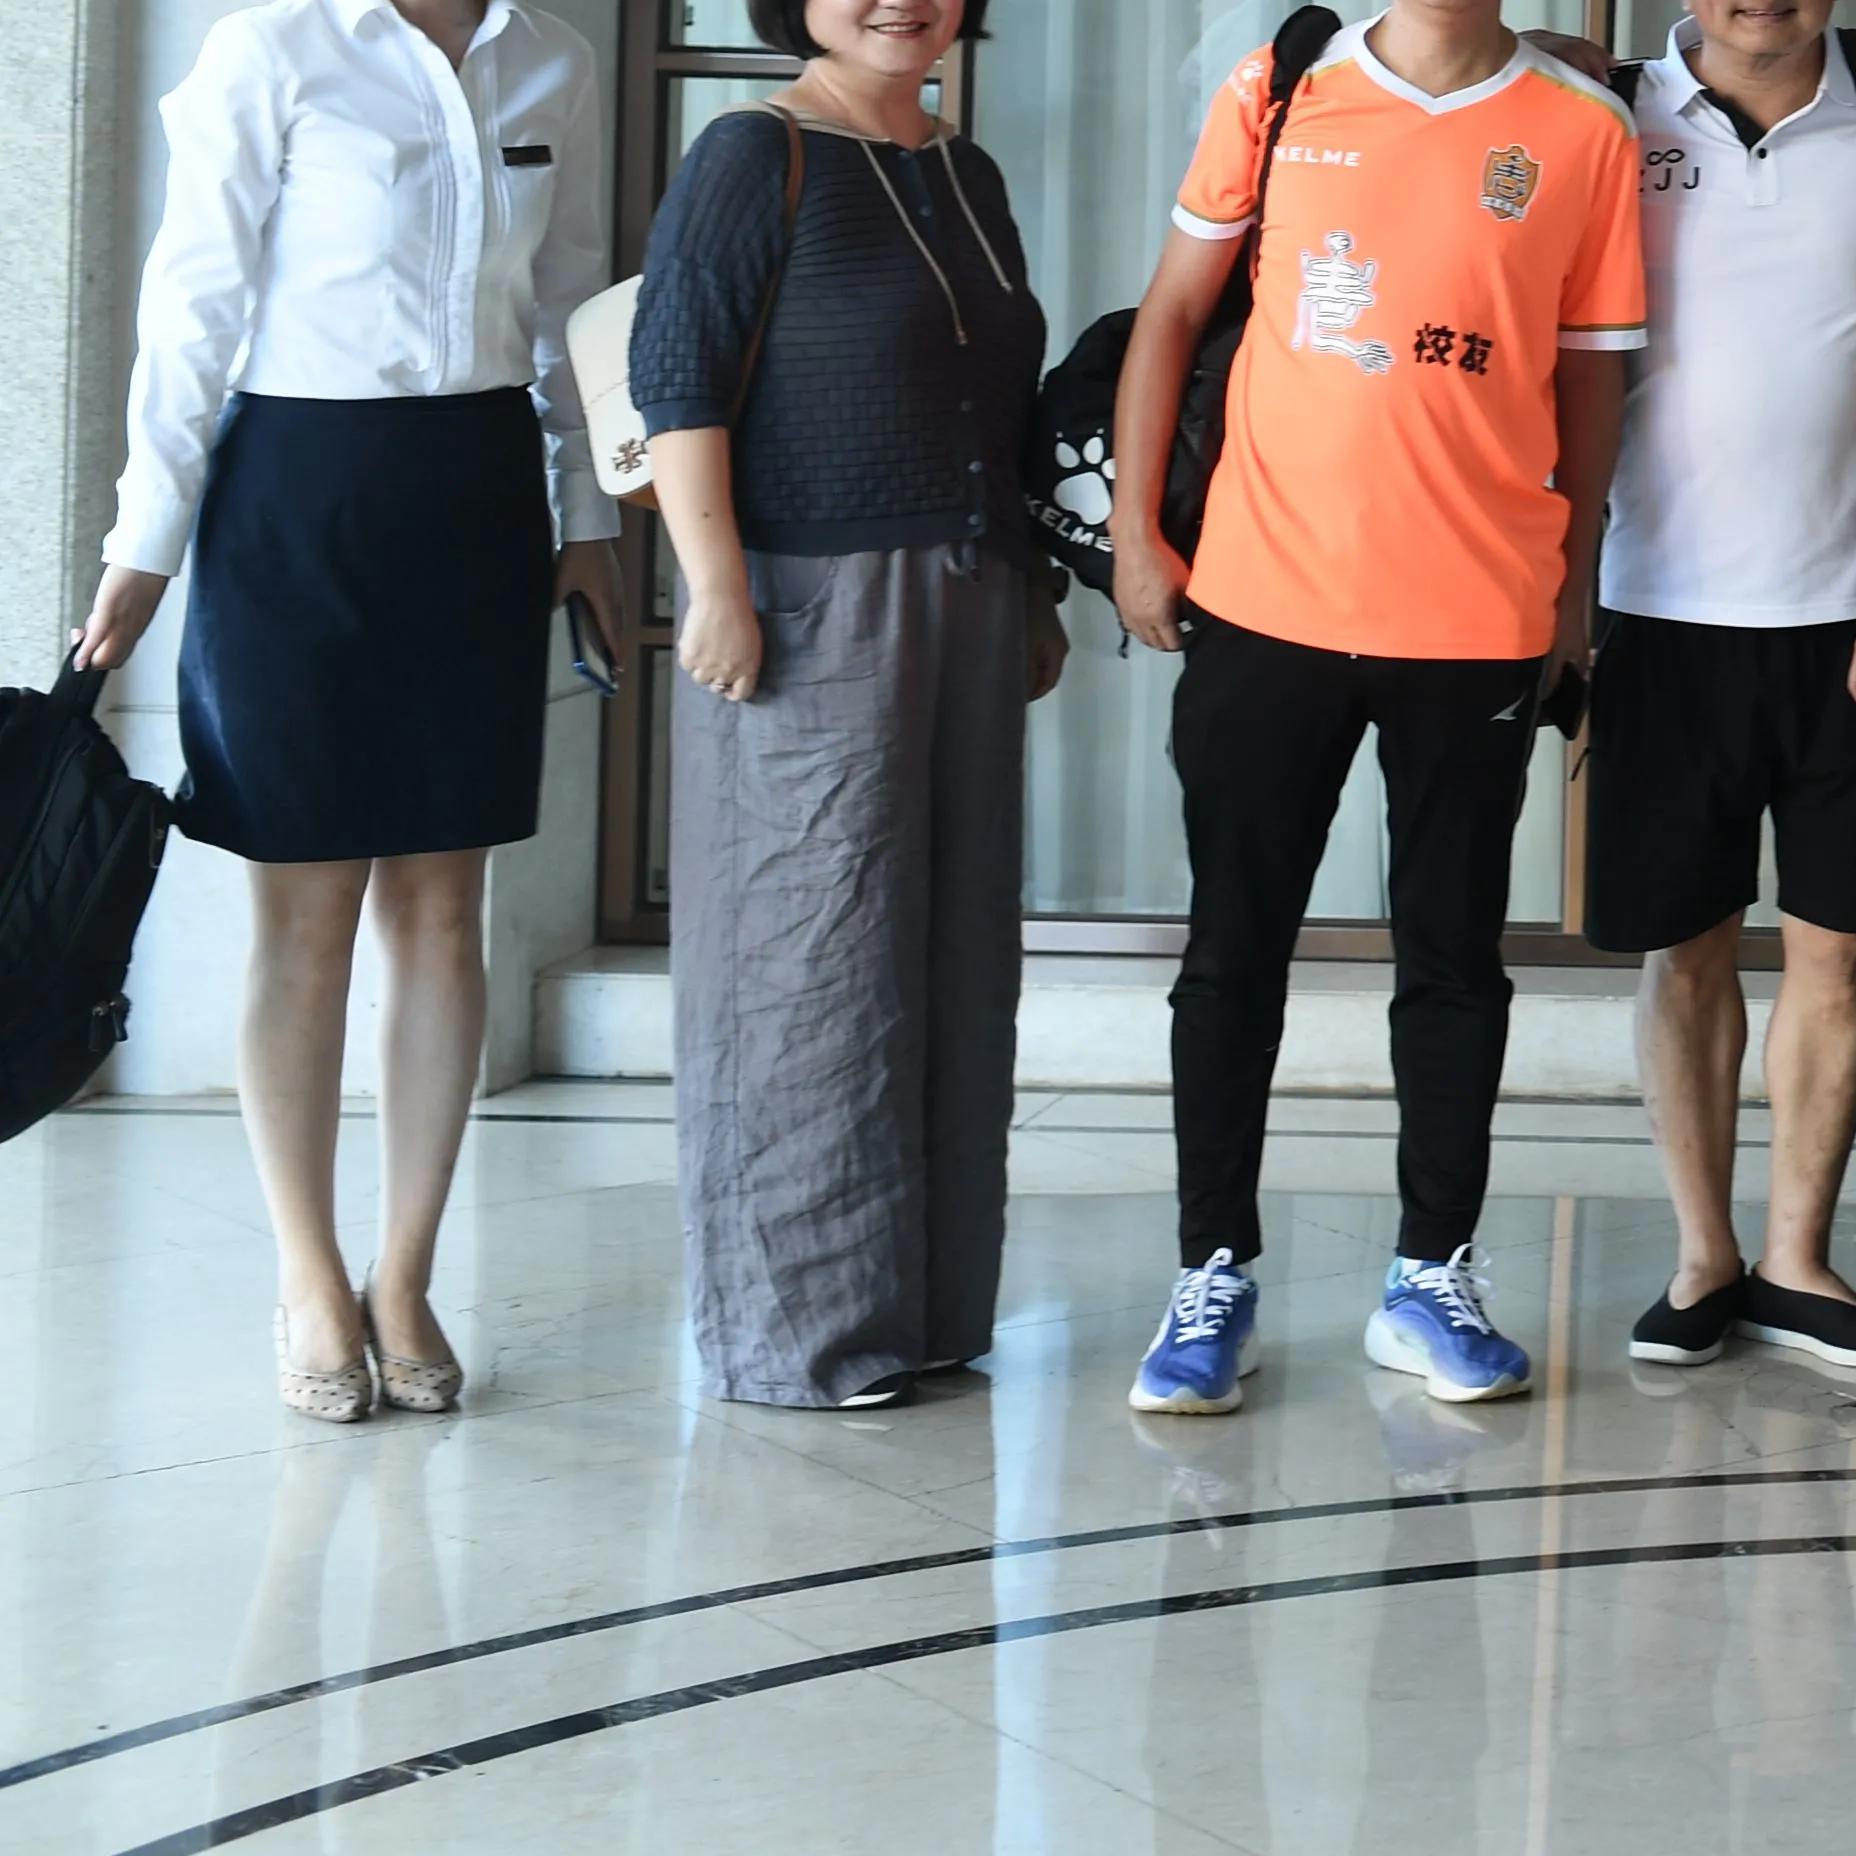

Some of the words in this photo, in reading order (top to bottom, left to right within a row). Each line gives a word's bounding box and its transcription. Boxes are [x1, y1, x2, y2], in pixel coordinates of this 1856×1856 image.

[1273, 144, 1363, 167] KELME
[1639, 166, 1702, 193] JJ
[1413, 322, 1494, 377] 校友
[1023, 493, 1114, 553] KELME
